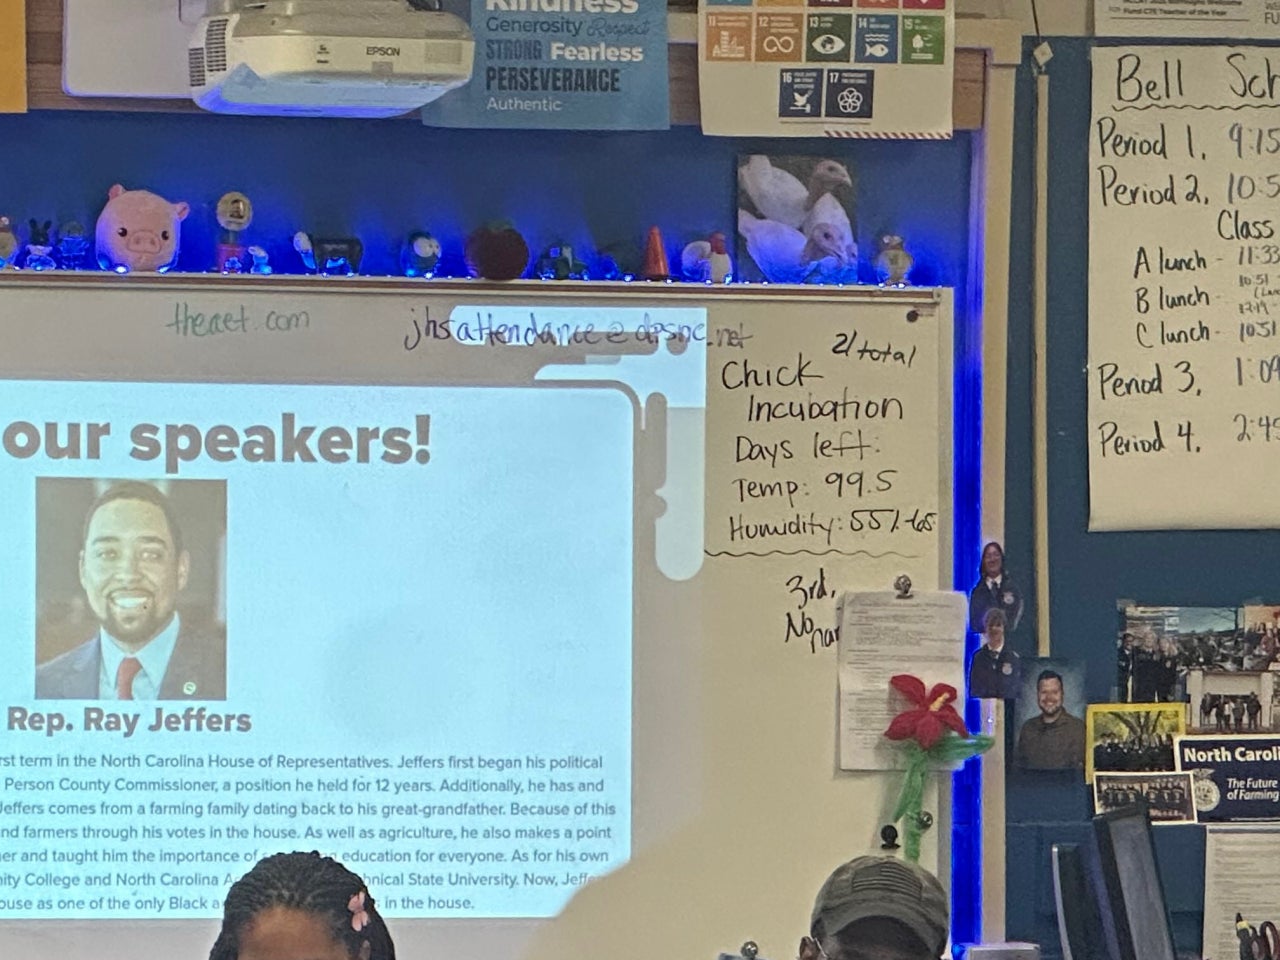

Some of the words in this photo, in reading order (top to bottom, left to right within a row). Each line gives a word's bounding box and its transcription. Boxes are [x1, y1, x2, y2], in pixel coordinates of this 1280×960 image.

[486, 16, 583, 37] Generosity
[586, 17, 651, 40] Respect
[708, 16, 716, 26] 11
[759, 16, 768, 27] 12
[810, 17, 819, 27] 13
[858, 18, 867, 28] 14
[903, 19, 913, 29] 15
[366, 46, 400, 56] EPSON
[486, 39, 542, 60] STRONG
[550, 42, 644, 62] Fearless
[486, 67, 621, 91] PERSEVERANCE
[783, 72, 792, 83] 16
[829, 72, 839, 83] 17
[1117, 53, 1183, 102] Bell
[486, 96, 562, 111] Authentic
[1097, 116, 1167, 159] Period
[1187, 124, 1206, 160] 1.
[1097, 164, 1176, 206] Period
[1185, 174, 1209, 205] 2.
[1218, 209, 1275, 240] Class
[1133, 246, 1151, 279] A
[1159, 246, 1207, 274] lunch
[1135, 287, 1150, 314] B
[1160, 285, 1210, 311] lunch
[1136, 322, 1154, 348] C
[1161, 320, 1210, 345] lunch
[856, 340, 916, 368] total
[722, 352, 824, 389] Chick
[1098, 362, 1163, 400] Period
[1174, 360, 1202, 397] 3.
[748, 386, 903, 422] Incubation
[2, 421, 110, 460] our
[129, 413, 431, 474] speakers!
[736, 436, 794, 468] Days
[813, 429, 880, 460] left:
[1098, 420, 1165, 458] Period
[1177, 421, 1200, 453] 4.
[732, 478, 810, 508] Temp:
[825, 469, 898, 497] 99.5
[730, 513, 844, 546] Humidity:
[784, 611, 814, 643] No
[7, 706, 74, 737] Rep.
[84, 707, 140, 738] Ray
[148, 707, 252, 732] Jeffers
[19, 755, 52, 767] term
[56, 754, 69, 767] in
[73, 754, 96, 767] the
[100, 754, 140, 767] North
[144, 754, 204, 767] Carolina
[208, 755, 254, 768] House
[257, 755, 273, 767] of
[276, 755, 393, 771] Representatives.
[396, 755, 444, 768] Jeffers
[447, 756, 473, 768] first
[477, 756, 521, 771] began
[525, 756, 545, 768] his
[549, 756, 602, 771] political
[1183, 747, 1232, 762] North
[1226, 778, 1245, 788] The
[1246, 778, 1278, 788] Future
[1227, 789, 1238, 800] of
[1239, 789, 1279, 802] Farming
[36, 899, 53, 909] as
[56, 899, 85, 909] one
[88, 897, 104, 909] of
[106, 897, 130, 909] the
[132, 896, 165, 912] only
[168, 896, 208, 909] Black
